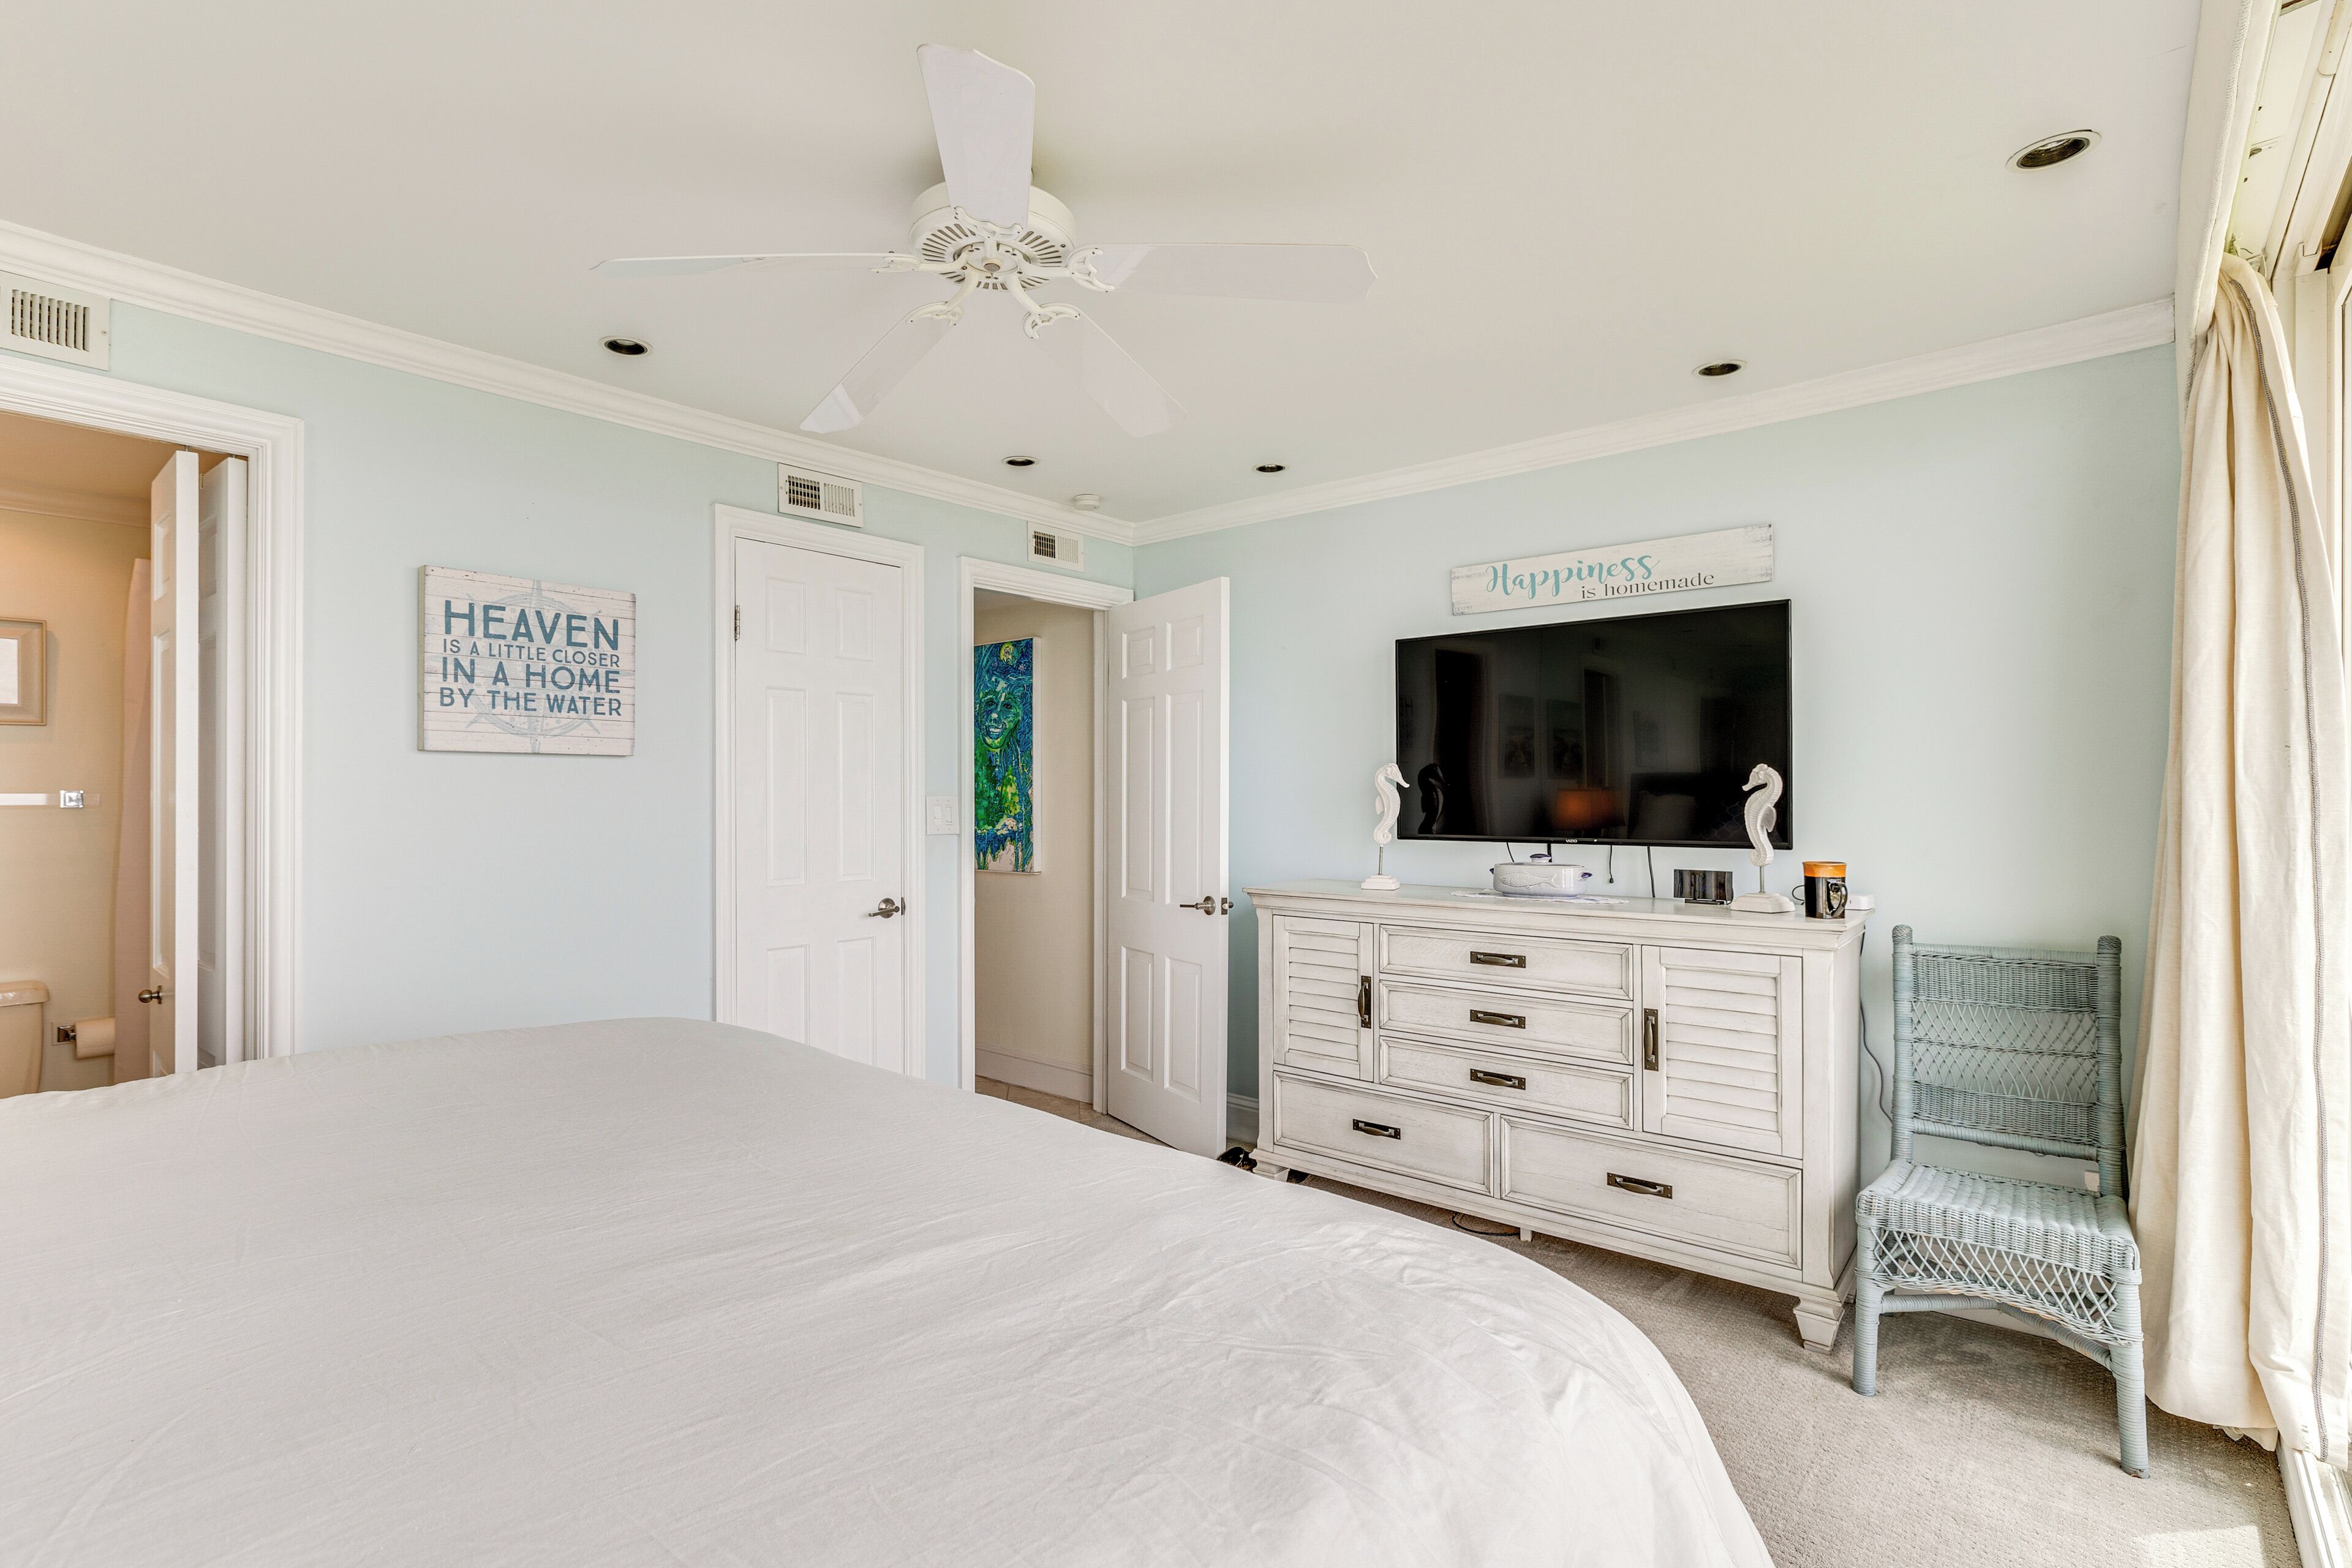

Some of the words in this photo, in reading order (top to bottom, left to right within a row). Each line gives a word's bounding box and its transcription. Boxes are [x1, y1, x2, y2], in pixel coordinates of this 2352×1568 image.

[1486, 555, 1659, 600] Happiness
[1581, 586, 1596, 598] is
[1604, 573, 1714, 596] homemade
[445, 600, 618, 650] HEAVEN
[443, 638, 461, 654] IS
[470, 641, 480, 656] A
[489, 643, 546, 662] LITTLE
[552, 649, 620, 667] CLOSER
[442, 657, 475, 684] IN
[492, 661, 510, 686] A
[526, 663, 620, 693] HOME
[440, 687, 474, 708] BY
[487, 690, 537, 712] THE
[546, 693, 622, 716] WATER
